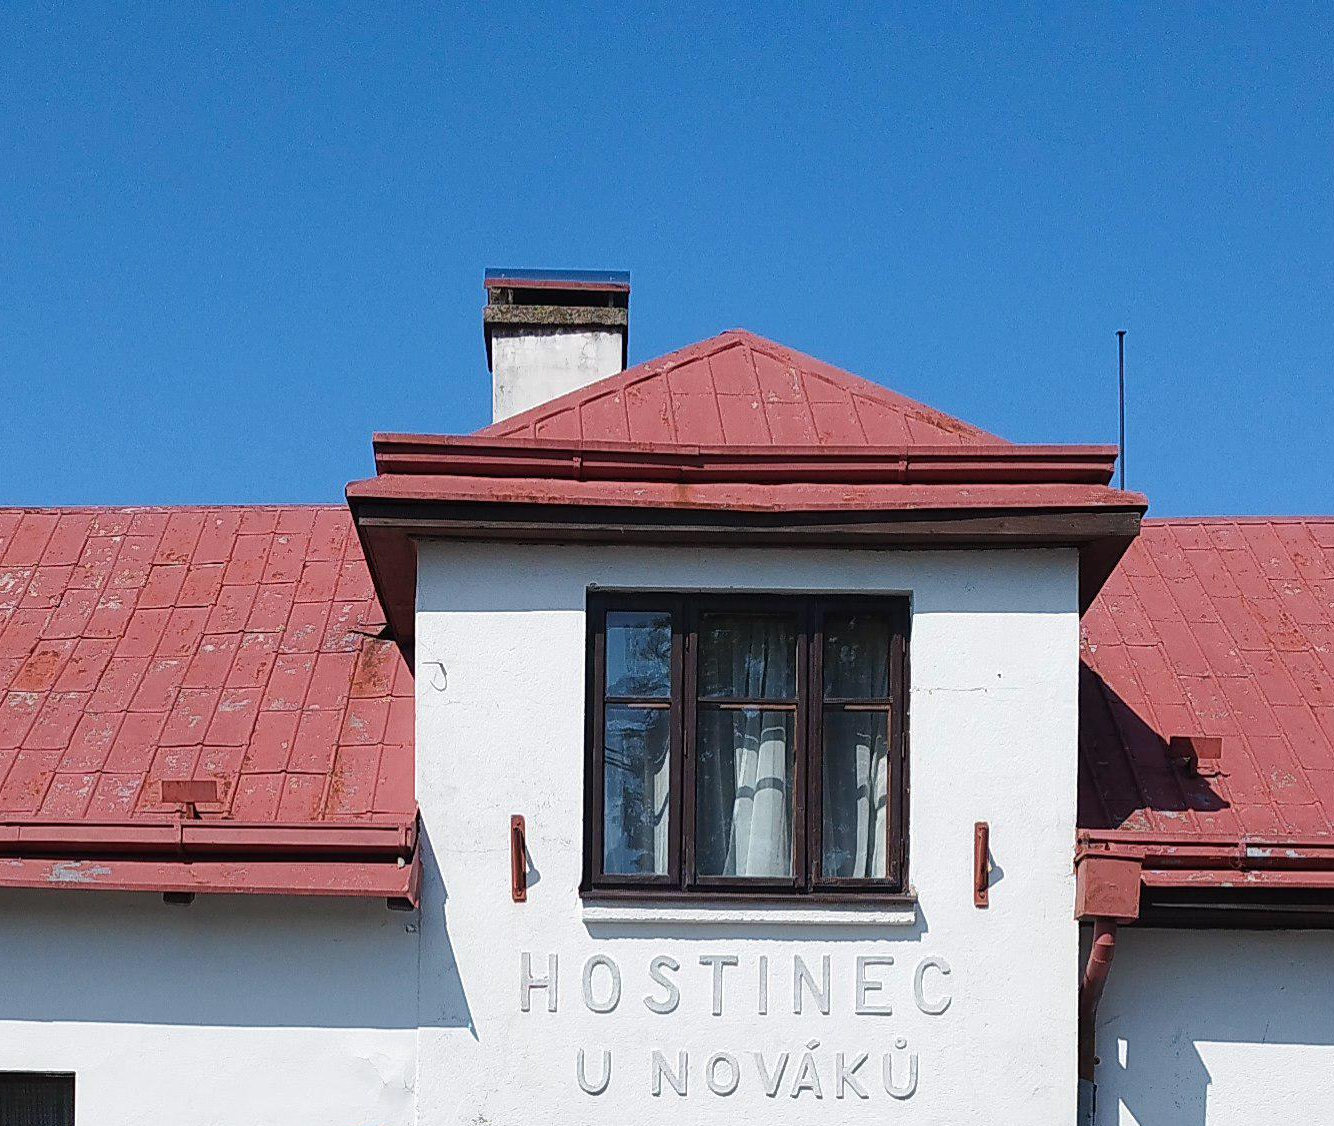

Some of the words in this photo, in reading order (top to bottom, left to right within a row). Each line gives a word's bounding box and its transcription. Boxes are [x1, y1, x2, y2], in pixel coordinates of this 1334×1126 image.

[519, 951, 953, 1017] HOSTINEC
[576, 1047, 612, 1097] U
[651, 1037, 920, 1100] NOVÁKŮ
